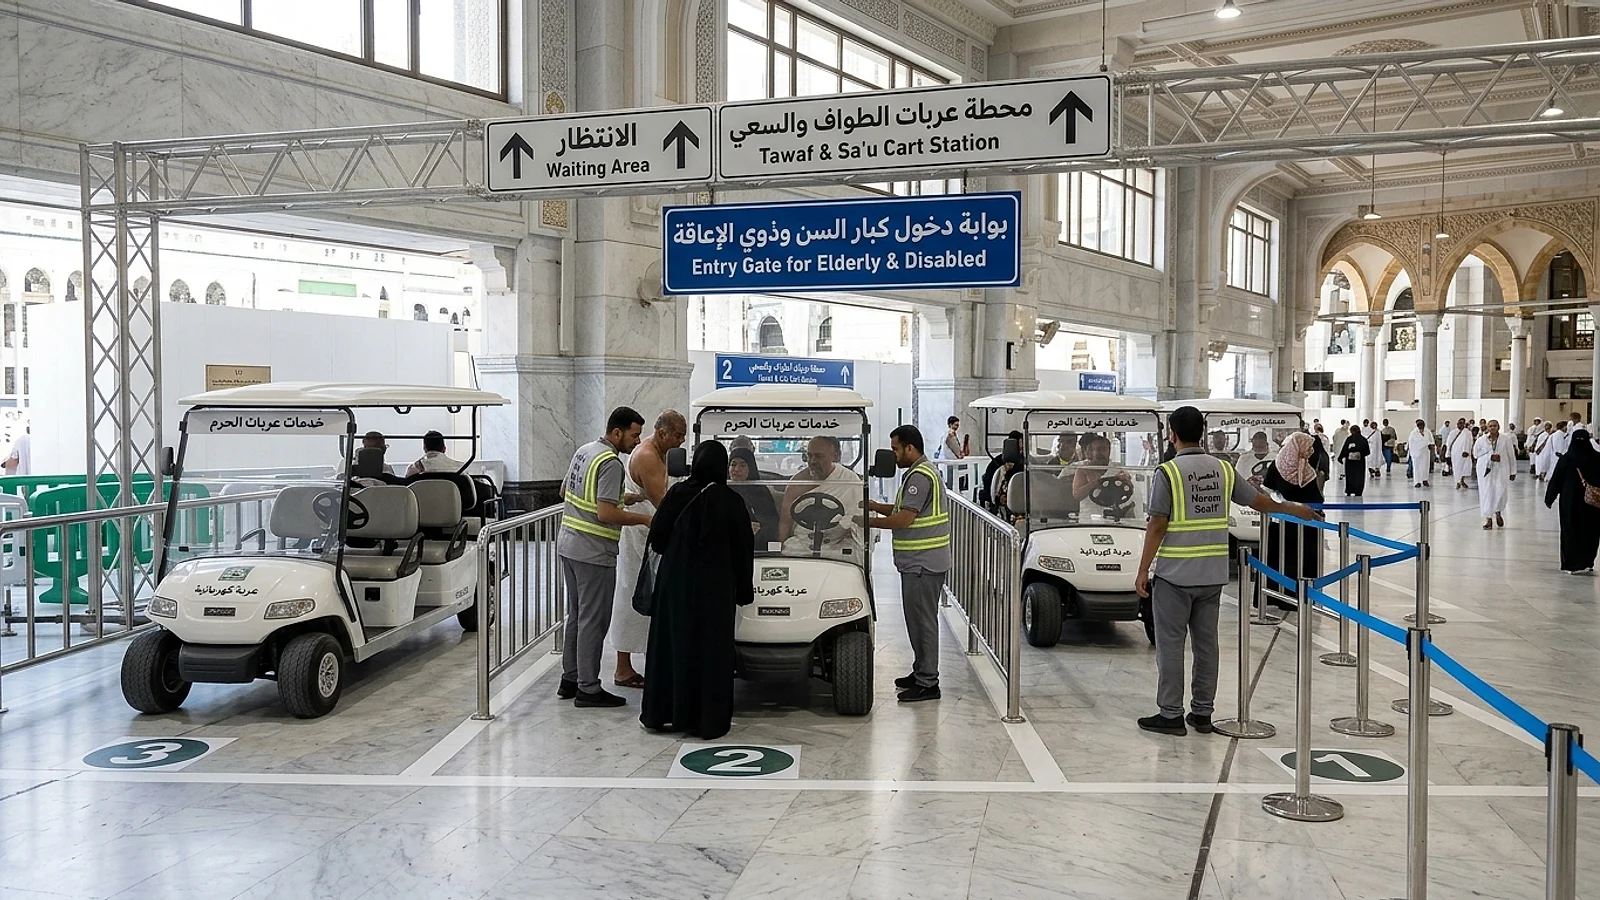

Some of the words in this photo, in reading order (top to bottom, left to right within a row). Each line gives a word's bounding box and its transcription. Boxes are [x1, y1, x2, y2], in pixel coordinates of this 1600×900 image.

[814, 105, 889, 131] الطواف
[896, 103, 959, 130] عربات
[965, 98, 1032, 121] محطة
[556, 122, 637, 157] الانتظار
[729, 112, 808, 148] والسعي
[759, 146, 814, 164] Tawaf
[819, 143, 832, 161] &
[838, 140, 878, 159] Sa'u
[883, 138, 924, 157] Cart
[930, 133, 1000, 154] Station
[546, 161, 606, 179] Waiting
[611, 158, 650, 174] Area
[673, 222, 734, 250] الإعاقة
[739, 221, 791, 253] وذوي
[796, 218, 846, 247] السن
[851, 217, 889, 245] كبار
[894, 215, 953, 243] دخول
[959, 212, 1008, 241] بوابة
[692, 258, 737, 278] Entry
[742, 256, 782, 273] Gate
[786, 254, 812, 272] for
[817, 252, 880, 274] Elderly
[886, 252, 899, 269] &
[905, 249, 987, 268] Disabled
[722, 359, 732, 380] 2
[209, 416, 242, 432] الحرم
[283, 416, 324, 428] خدمات
[724, 417, 756, 432] الحرم
[760, 418, 795, 432] عربات
[798, 418, 840, 429] خدمات
[109, 741, 182, 764] 3
[706, 748, 764, 772] 2
[1313, 753, 1372, 777] 1
